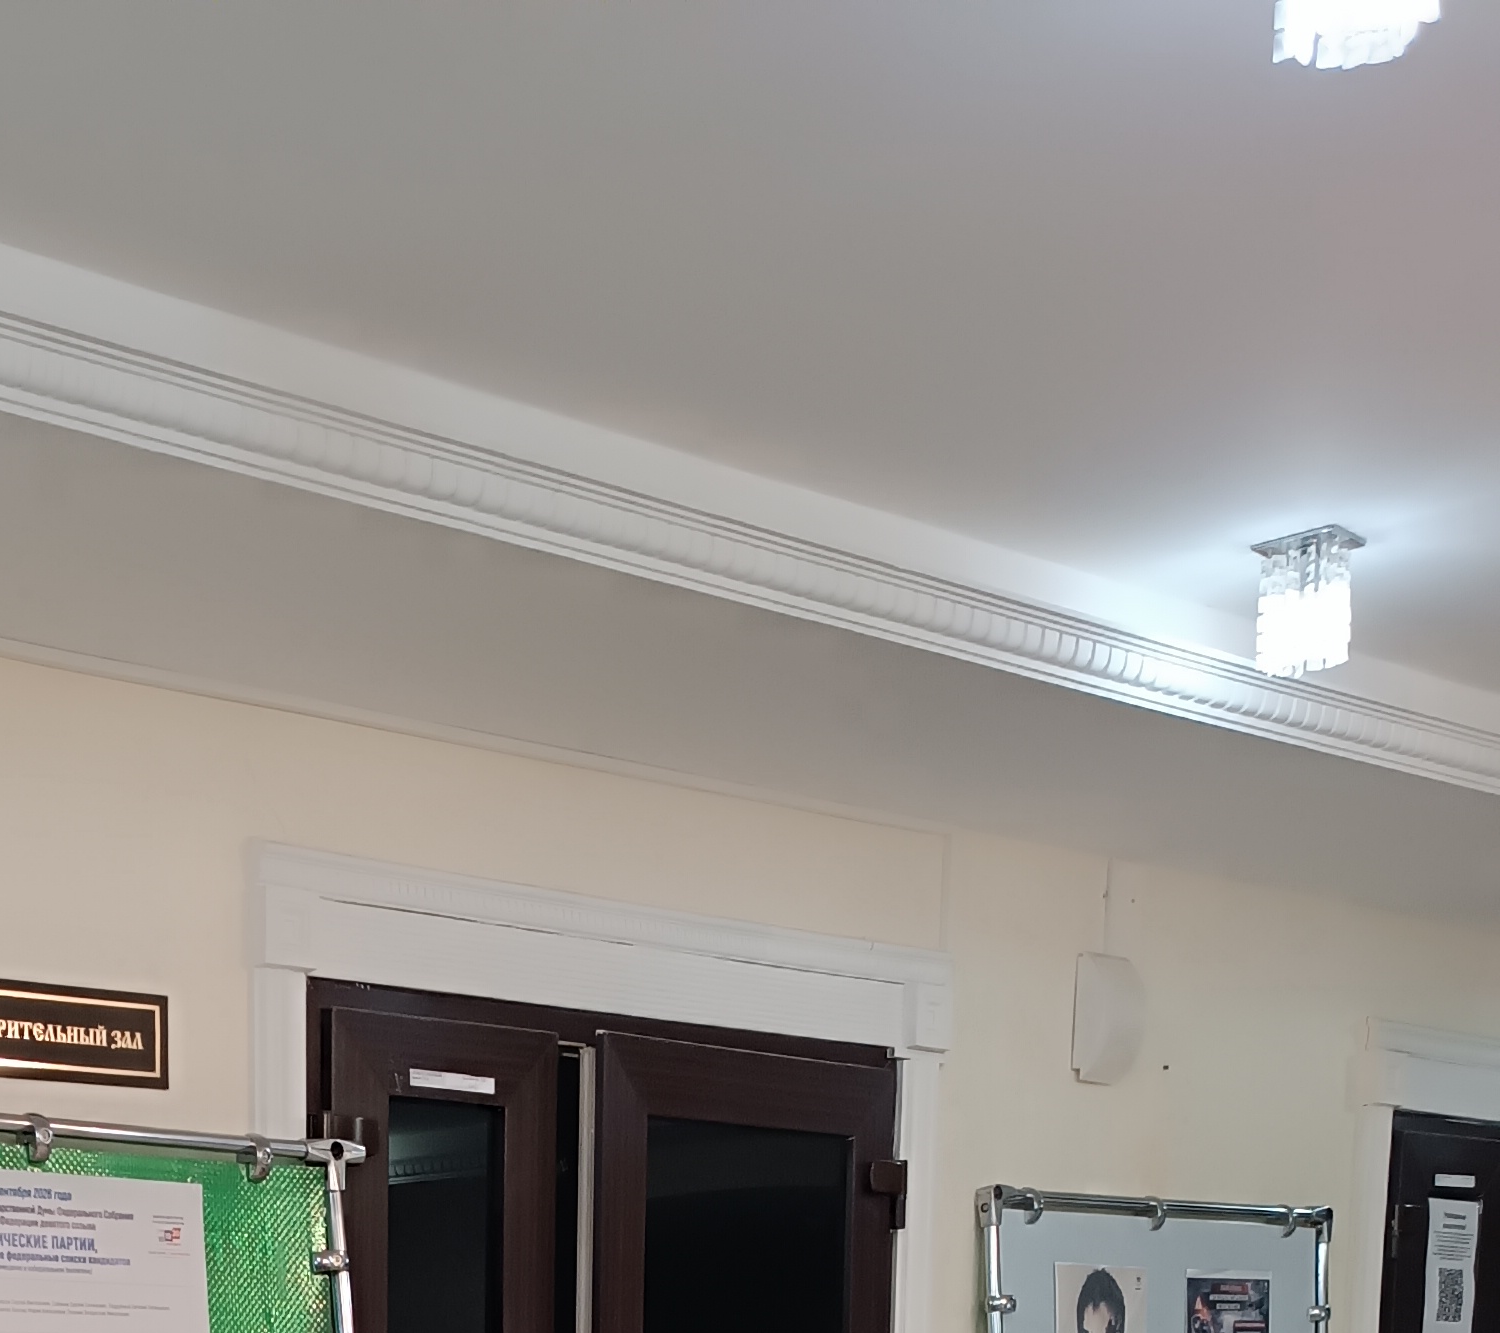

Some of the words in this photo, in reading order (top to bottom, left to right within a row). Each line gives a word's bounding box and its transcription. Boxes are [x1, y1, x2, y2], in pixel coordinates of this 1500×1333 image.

[110, 1030, 144, 1050] ЗАЛ
[54, 1190, 72, 1201] года
[52, 1235, 98, 1253] ПАРТИИ,
